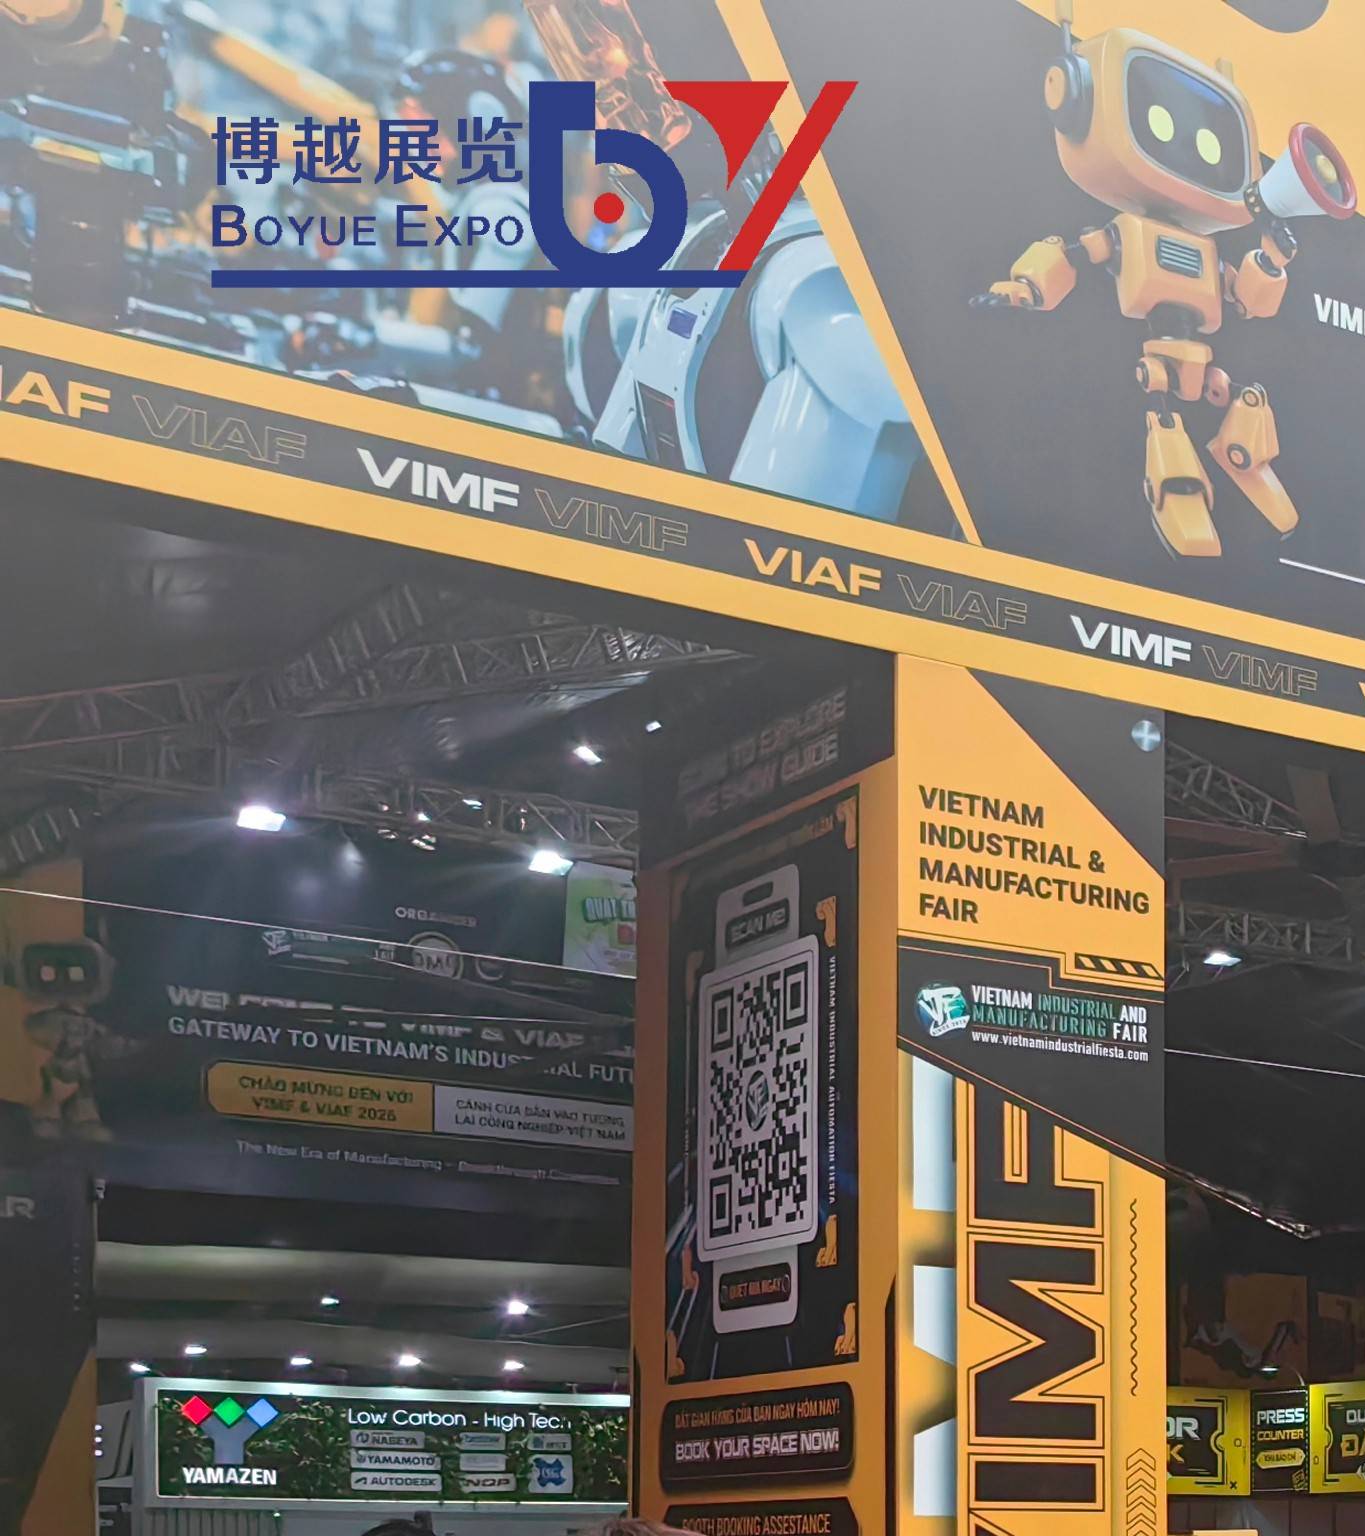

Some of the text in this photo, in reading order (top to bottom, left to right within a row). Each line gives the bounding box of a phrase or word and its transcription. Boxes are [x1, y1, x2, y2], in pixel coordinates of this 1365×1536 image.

[355, 447, 520, 512] VIMF
[743, 538, 883, 598] VIAF
[1070, 614, 1192, 667] VIMF
[919, 785, 1044, 828] VIETNAM
[919, 823, 1105, 873] INDUSTRIAL &
[919, 858, 1150, 914] MANUFACTURING
[919, 893, 979, 924] FAIR
[972, 985, 1147, 1023] VIETNAM INDUSTRIAL AND
[169, 1016, 281, 1046] GATEWAY
[288, 1029, 318, 1047] TO
[972, 1007, 1147, 1043] MANUFACTURING FAIR
[971, 1030, 1149, 1063] www.vietnamindustrialfiesta.com
[347, 1408, 388, 1425] Low
[392, 1409, 467, 1427] Carbon
[484, 1412, 525, 1431] High
[1257, 1408, 1305, 1425] PRESS
[676, 1429, 839, 1461] BOOK YOUR SPACE NOW!
[1257, 1429, 1305, 1441] COUNTER
[367, 1455, 435, 1466] YAMAMOTO
[183, 1467, 277, 1486] YAMAZEN
[371, 1477, 437, 1486] AUTODESK
[718, 1517, 760, 1536] BOOKING
